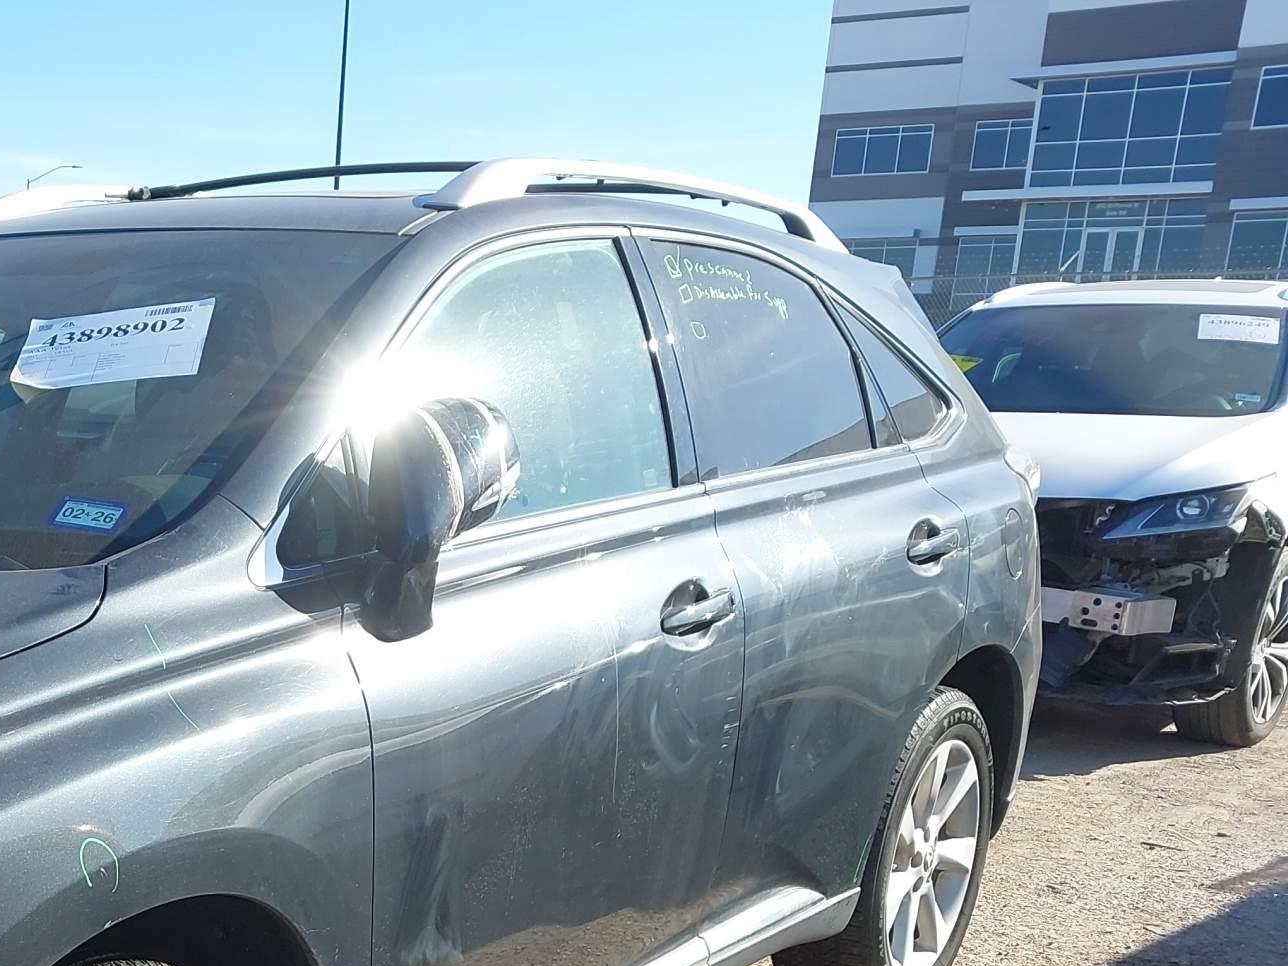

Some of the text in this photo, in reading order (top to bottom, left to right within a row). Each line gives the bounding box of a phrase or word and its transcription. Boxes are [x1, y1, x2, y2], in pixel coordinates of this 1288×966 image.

[42, 317, 186, 347] 43898902
[62, 506, 117, 524] 02 26
